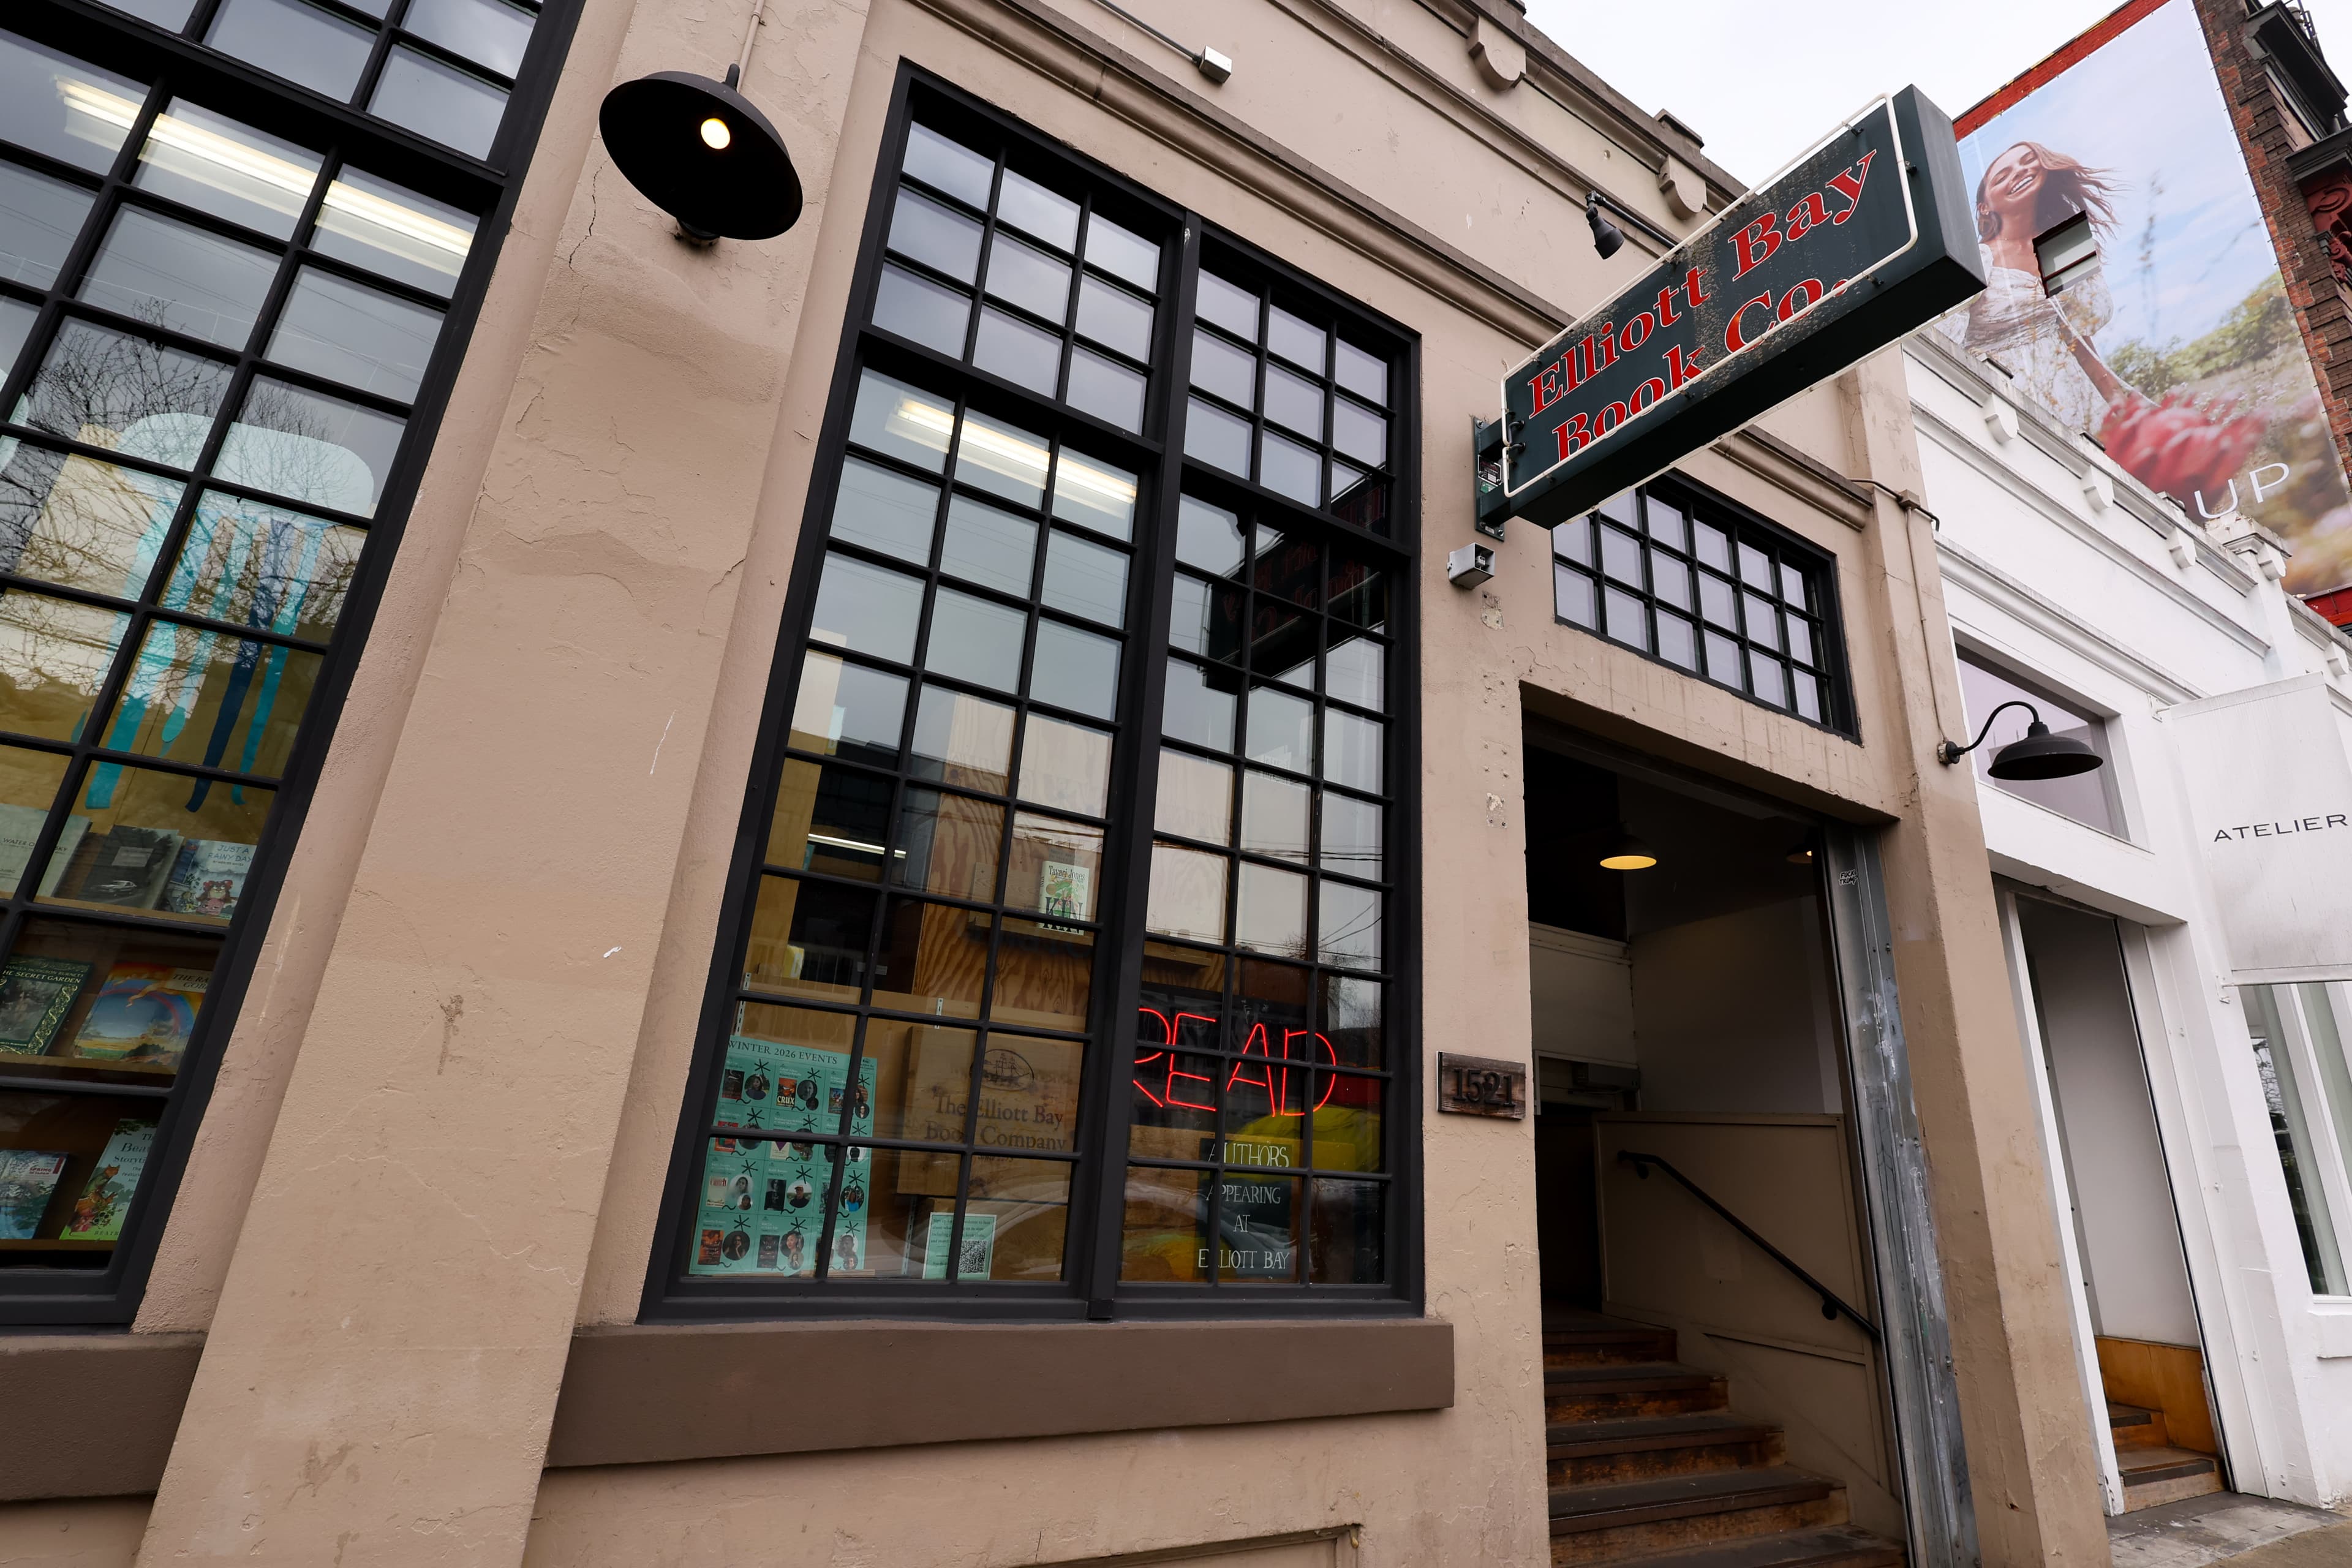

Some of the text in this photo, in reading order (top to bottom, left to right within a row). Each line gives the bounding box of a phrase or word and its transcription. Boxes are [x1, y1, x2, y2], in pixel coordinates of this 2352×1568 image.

[1527, 149, 1877, 420] Elliott Bay
[1551, 276, 1850, 464] Book Co.
[2194, 462, 2290, 519] UP
[2214, 813, 2349, 842] ATELIER
[207, 852, 234, 861] RAINY
[1068, 869, 1085, 881] Jones
[1839, 876, 1858, 884] TRUMP
[1042, 896, 1084, 934] KIN
[15, 971, 47, 980] SECRET
[47, 975, 81, 984] GARDEN
[728, 1040, 838, 1065] WINTER 2026 EVENTS
[1133, 1008, 1338, 1118] READ
[777, 1095, 795, 1105] CRUX
[1452, 1068, 1516, 1107] 1521
[933, 1094, 966, 1115] The
[1032, 1104, 1064, 1131] Bay
[121, 1142, 147, 1153] Bea
[924, 1120, 1068, 1151] Boo Company
[1233, 1214, 1251, 1233] AT
[1198, 1248, 1291, 1269] ELIOTT BAY
